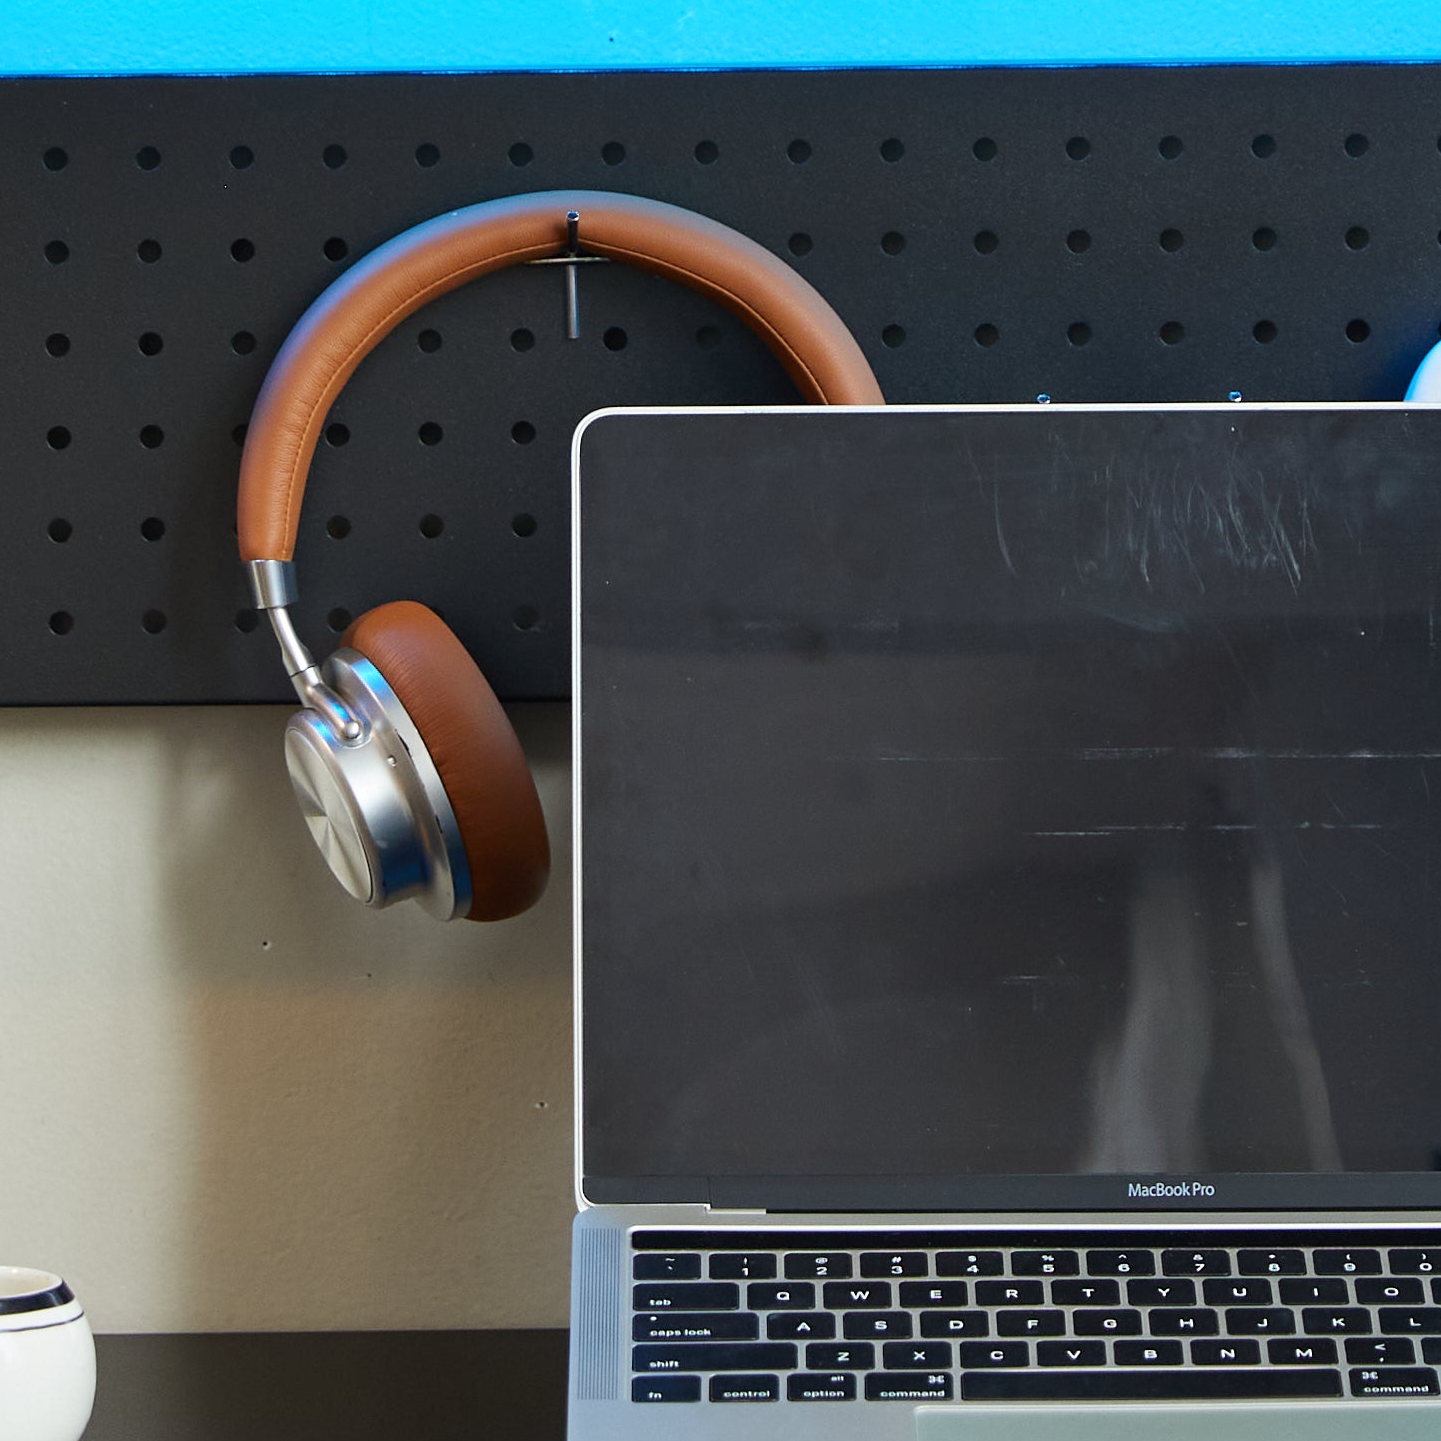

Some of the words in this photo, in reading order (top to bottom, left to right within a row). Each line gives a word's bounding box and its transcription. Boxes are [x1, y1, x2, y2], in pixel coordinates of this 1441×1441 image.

[1128, 1182, 1191, 1197] MacBook
[1192, 1182, 1215, 1196] Pro
[650, 1298, 670, 1306] tab
[776, 1291, 790, 1301] Q
[851, 1290, 869, 1300] W
[930, 1289, 942, 1299] E
[1006, 1289, 1019, 1298] R
[1082, 1289, 1094, 1297] T
[1158, 1288, 1170, 1296] Y
[1233, 1288, 1246, 1296] U
[1314, 1288, 1318, 1296] I
[1384, 1287, 1399, 1296] O
[650, 1329, 681, 1338] caps
[685, 1328, 711, 1336] lock
[796, 1322, 811, 1332] A
[875, 1321, 887, 1331] S
[949, 1320, 963, 1330] D
[1027, 1320, 1038, 1329] F
[1103, 1319, 1117, 1328] G
[1180, 1319, 1193, 1328] H
[1257, 1318, 1267, 1327] J
[1332, 1318, 1345, 1326] K
[1410, 1318, 1420, 1326] L
[649, 1360, 679, 1368] shift
[838, 1351, 849, 1361] Z
[913, 1350, 925, 1360] X
[990, 1350, 1003, 1360] C
[1067, 1350, 1081, 1359] V
[1144, 1350, 1157, 1359] B
[1221, 1349, 1235, 1358] N
[1296, 1349, 1312, 1358] M
